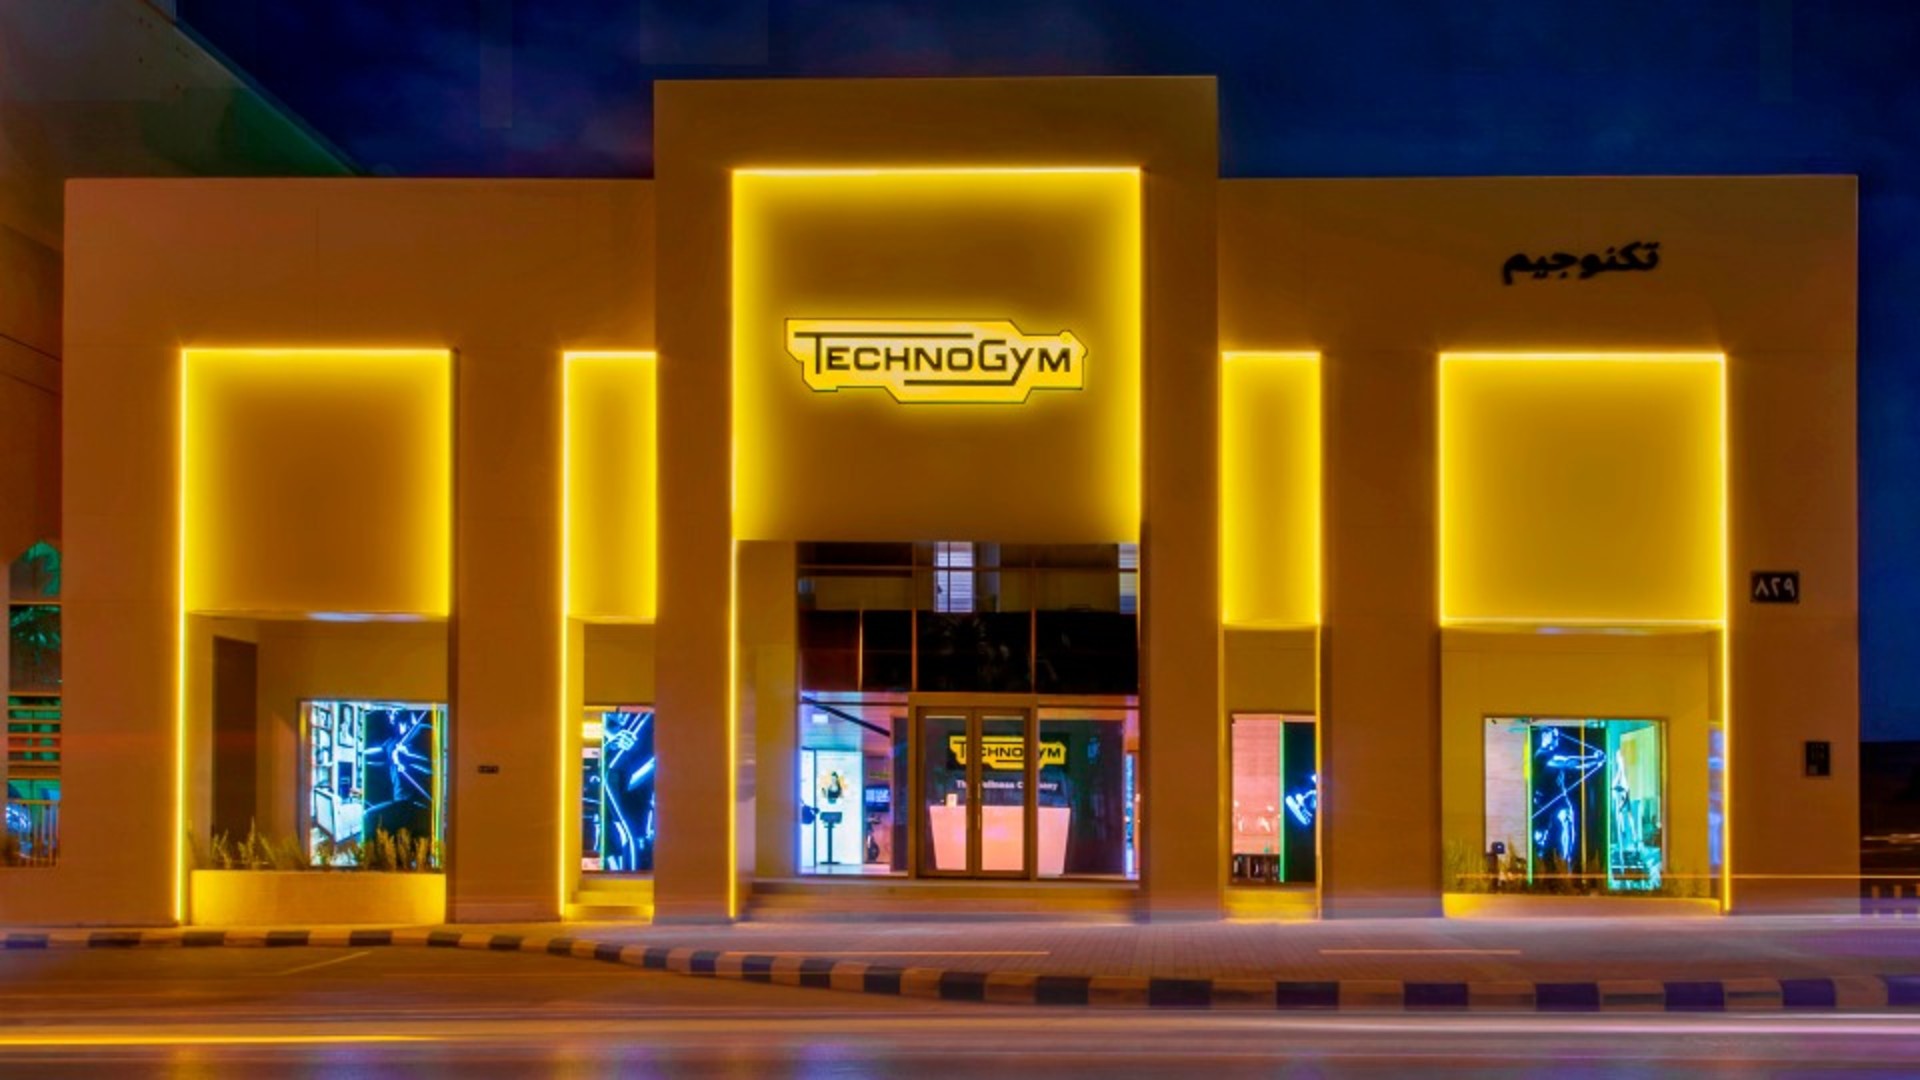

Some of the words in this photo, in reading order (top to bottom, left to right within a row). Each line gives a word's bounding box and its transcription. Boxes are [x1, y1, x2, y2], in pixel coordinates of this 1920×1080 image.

[1503, 241, 1660, 285] تكنوجيم
[794, 331, 1071, 386] TECHNOGYM
[953, 741, 1061, 763] TCHNOYM
